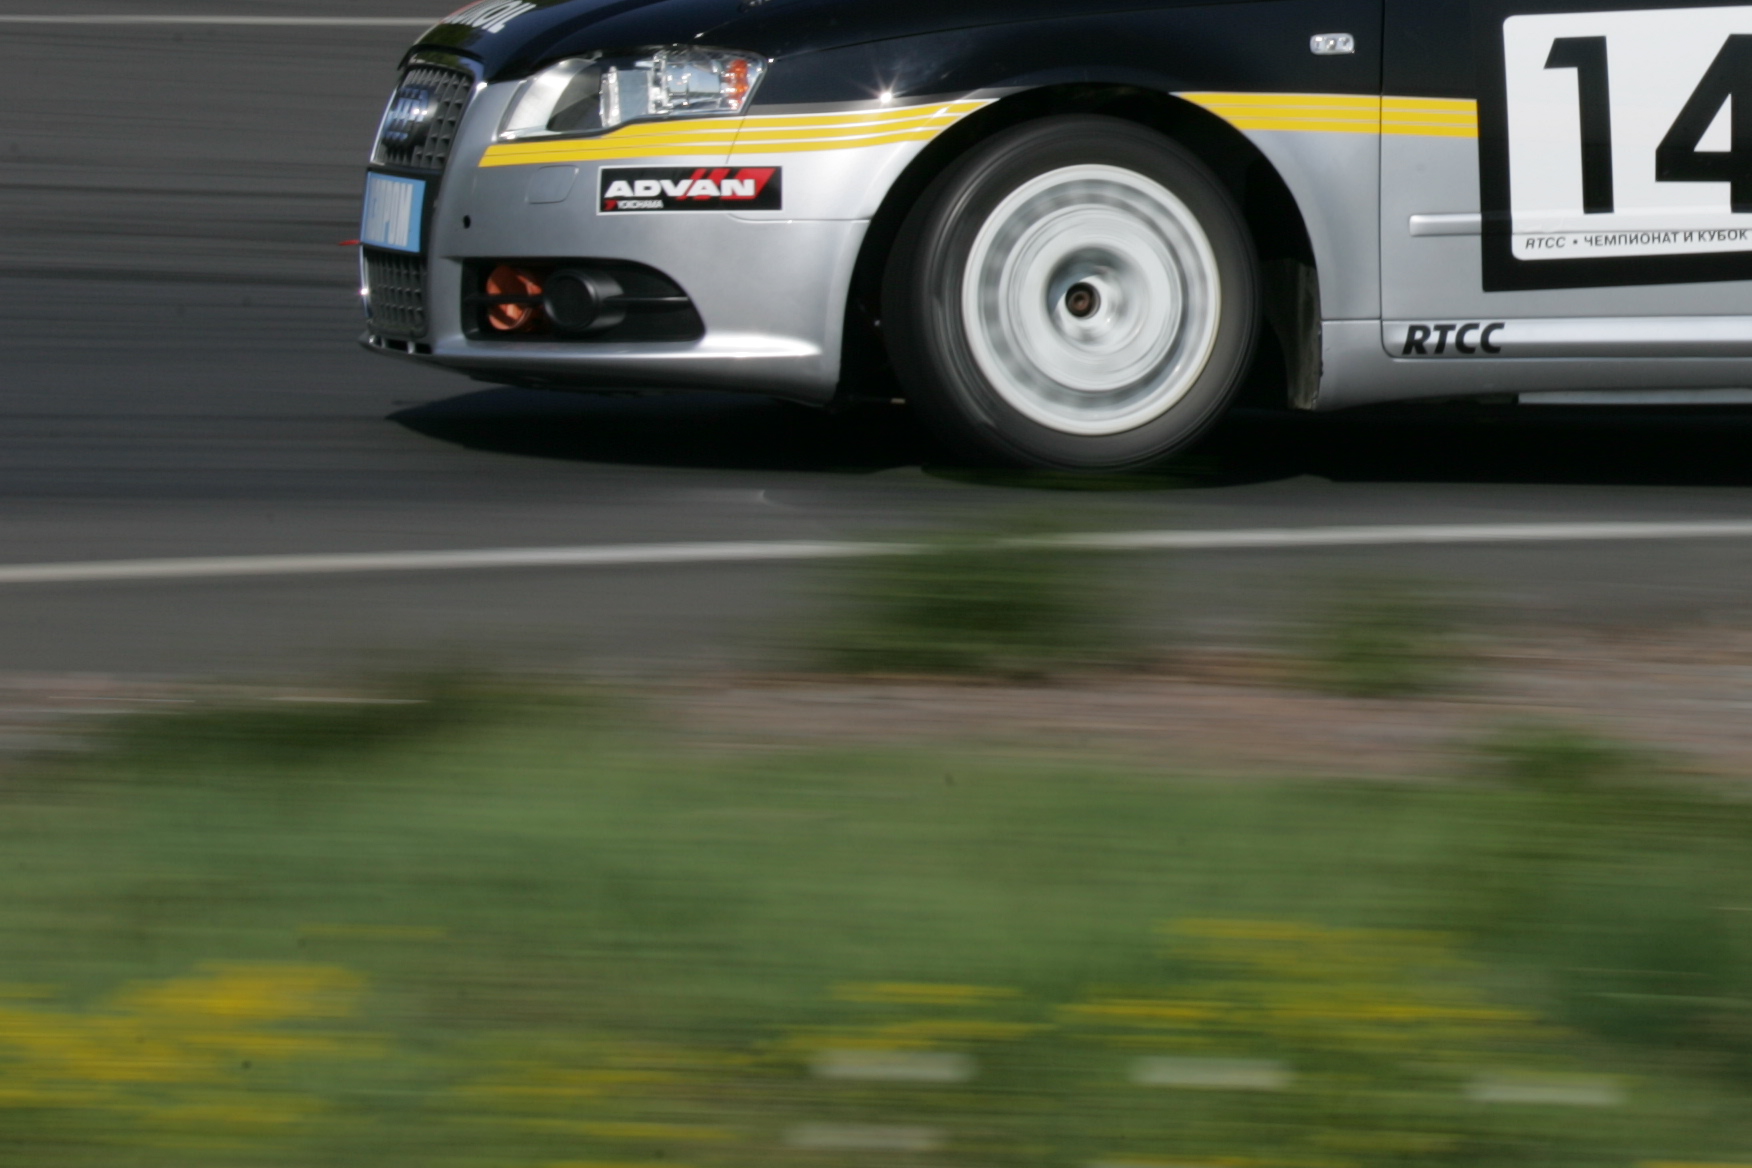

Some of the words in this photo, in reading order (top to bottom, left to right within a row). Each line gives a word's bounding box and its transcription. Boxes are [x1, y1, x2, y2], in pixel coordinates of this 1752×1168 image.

[604, 178, 756, 198] ADVAN
[1525, 236, 1567, 250] RTCC
[1583, 231, 1680, 248] ЧЕМПИОНАТ
[1683, 230, 1694, 243] И
[1697, 228, 1748, 243] КУБОК
[1401, 322, 1506, 356] RTCC
